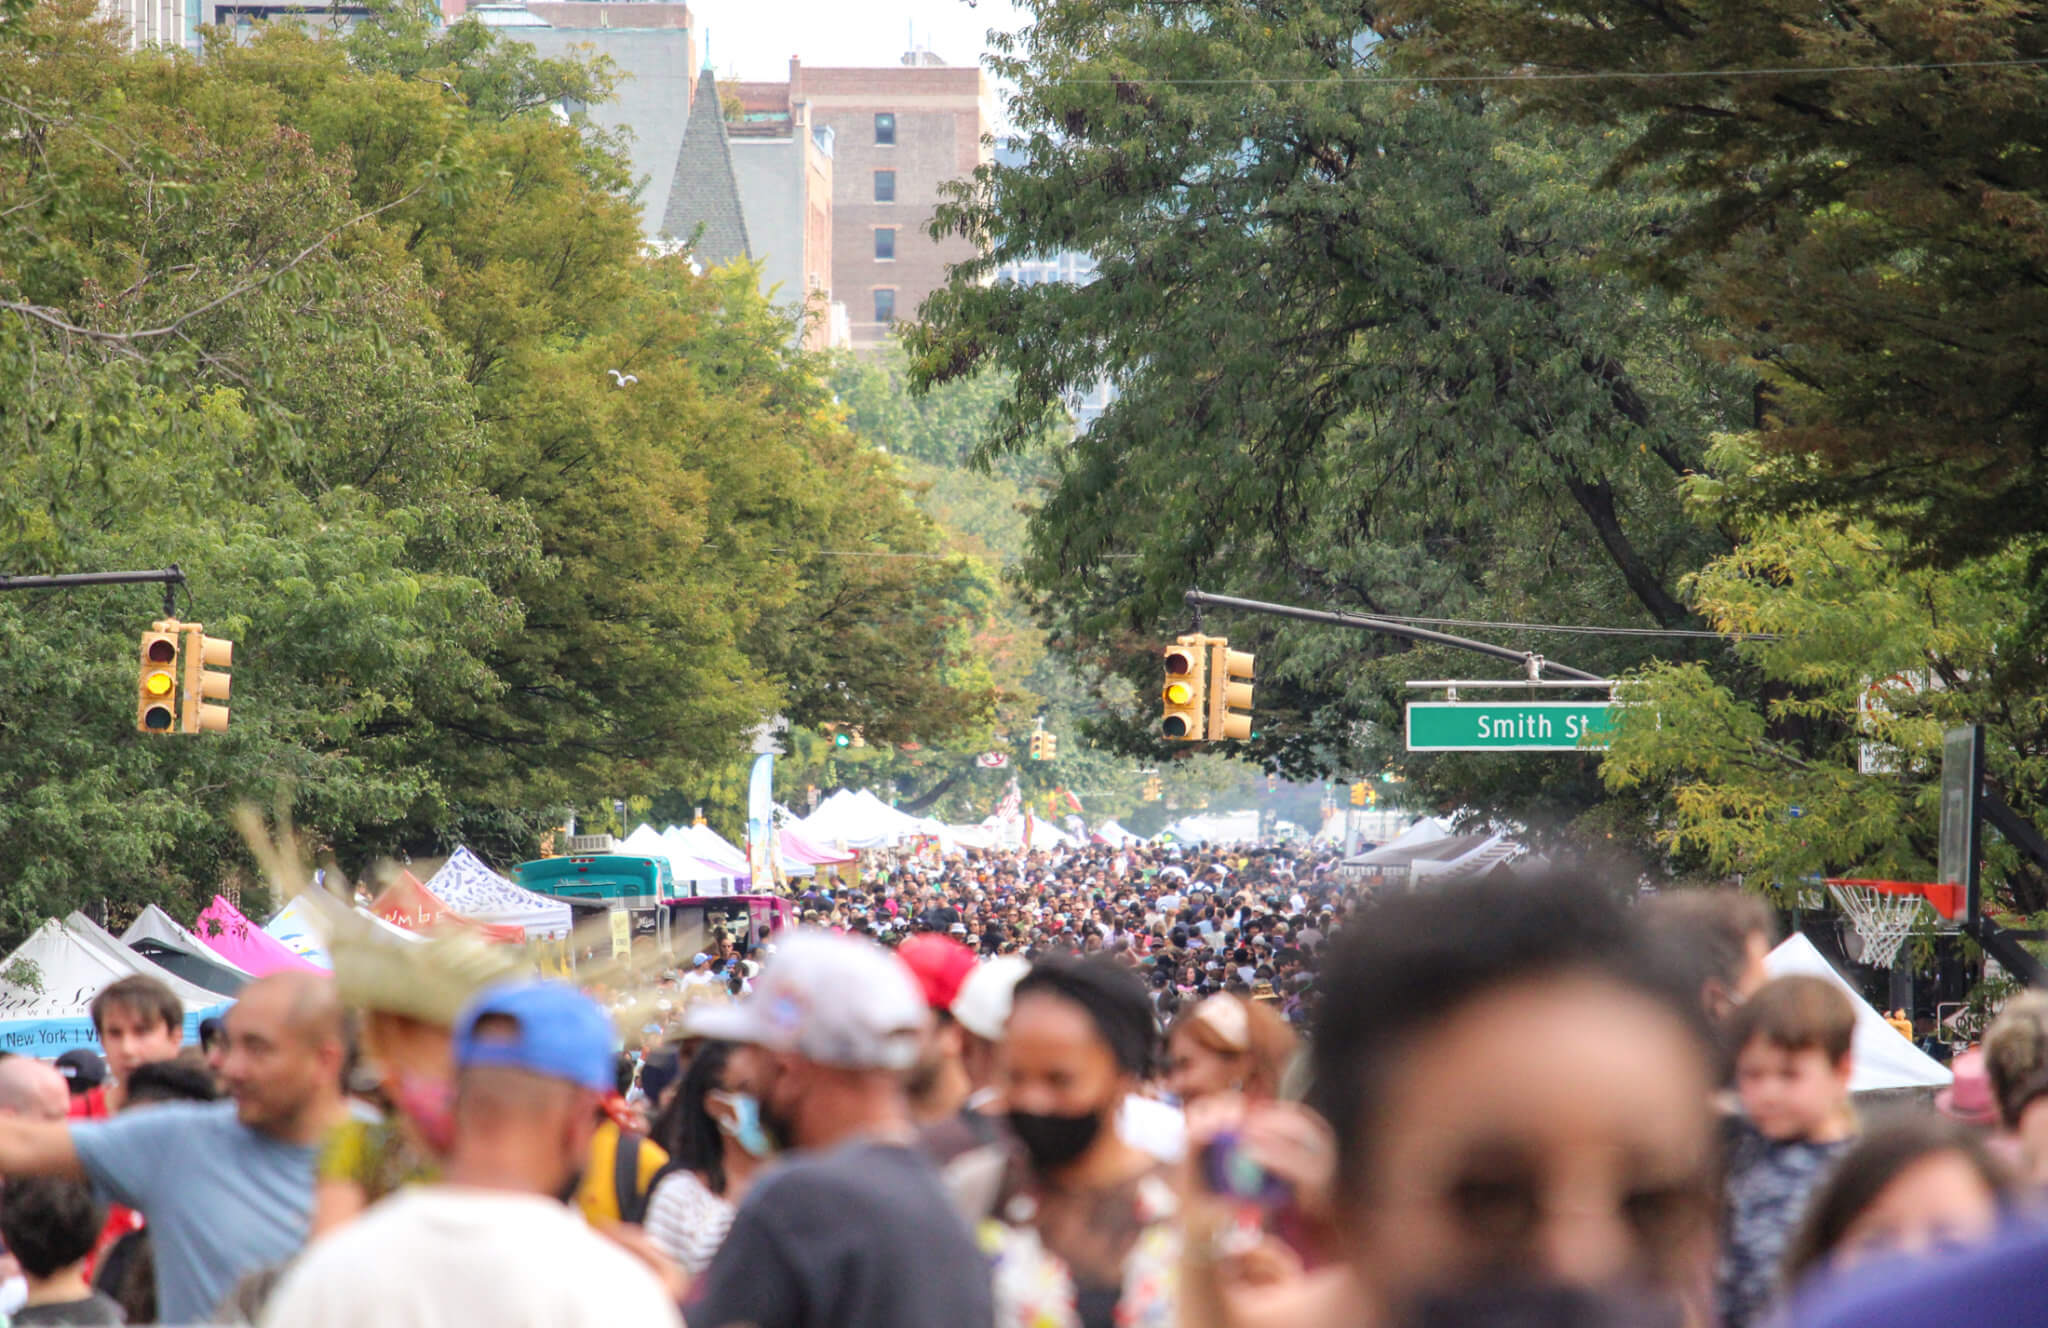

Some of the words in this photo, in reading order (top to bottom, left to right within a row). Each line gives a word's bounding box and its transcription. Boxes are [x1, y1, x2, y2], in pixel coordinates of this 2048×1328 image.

[1477, 713, 1552, 738] Smith
[1565, 714, 1589, 738] St
[6, 1031, 34, 1048] New
[39, 1028, 68, 1044] York
